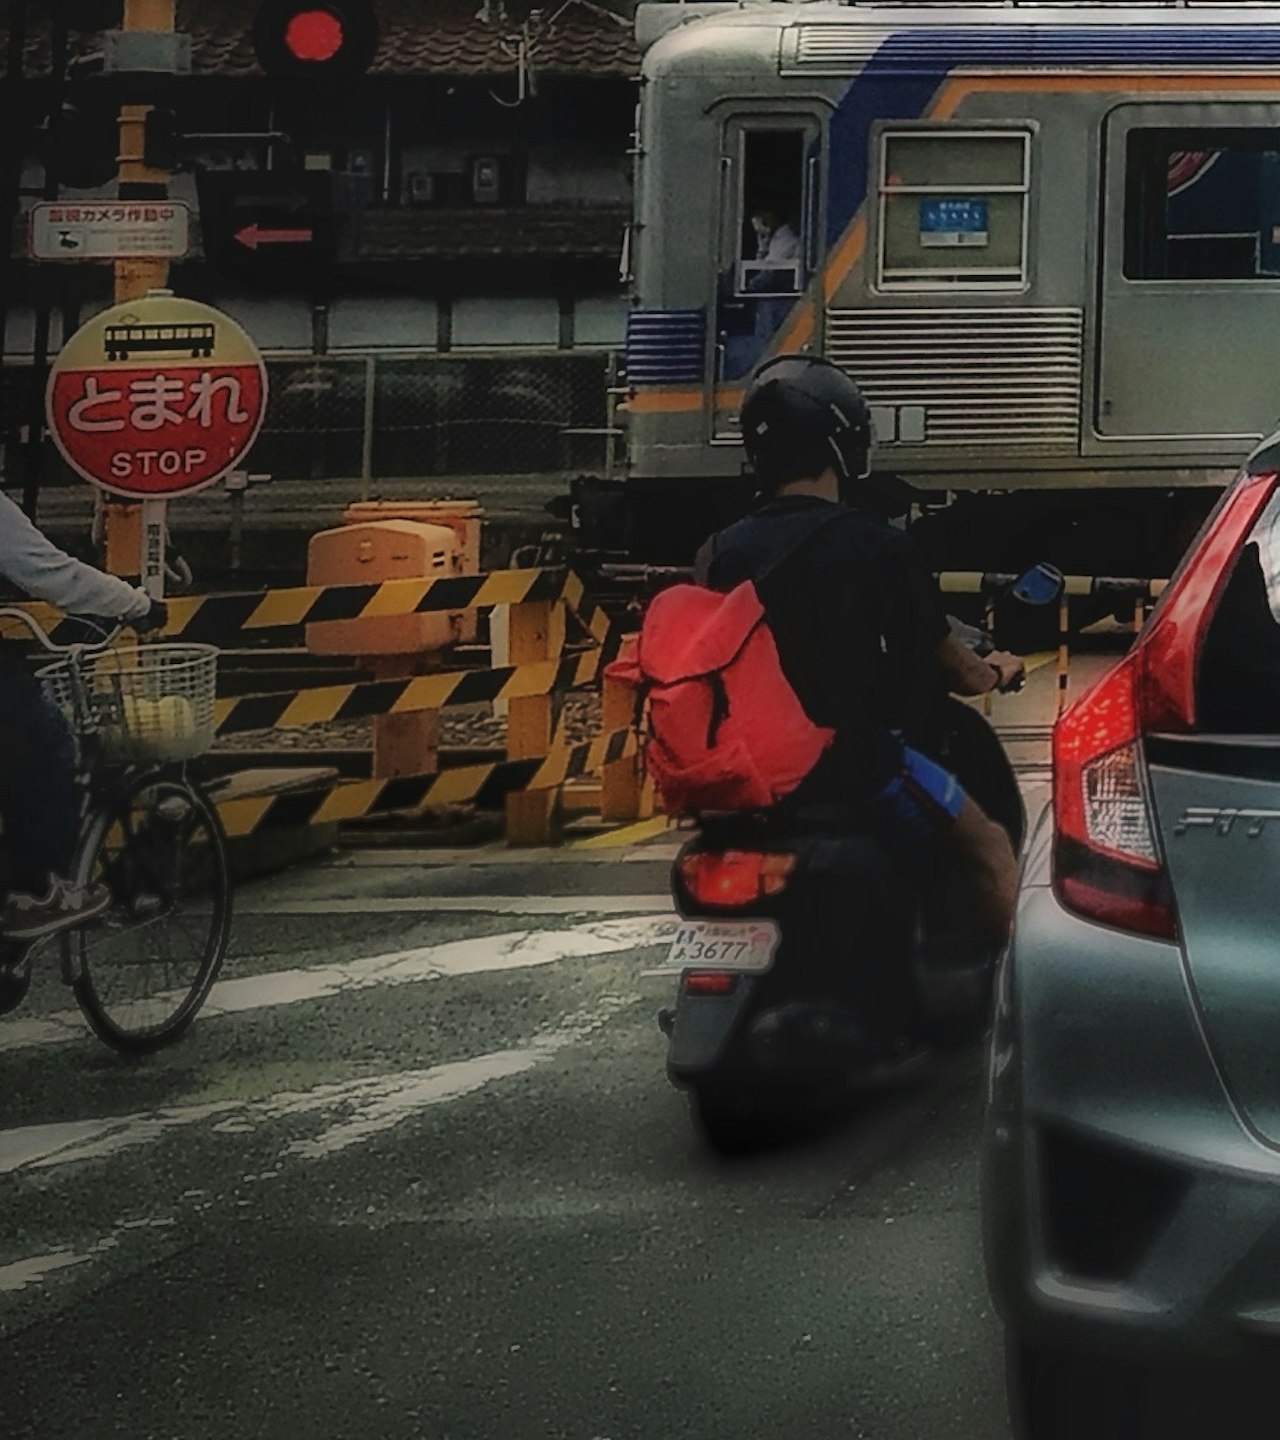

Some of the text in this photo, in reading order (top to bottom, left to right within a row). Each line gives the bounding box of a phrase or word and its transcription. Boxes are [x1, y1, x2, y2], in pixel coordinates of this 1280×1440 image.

[68, 372, 249, 431] とまれ
[110, 449, 207, 477] STOP
[689, 941, 748, 960] 3677
